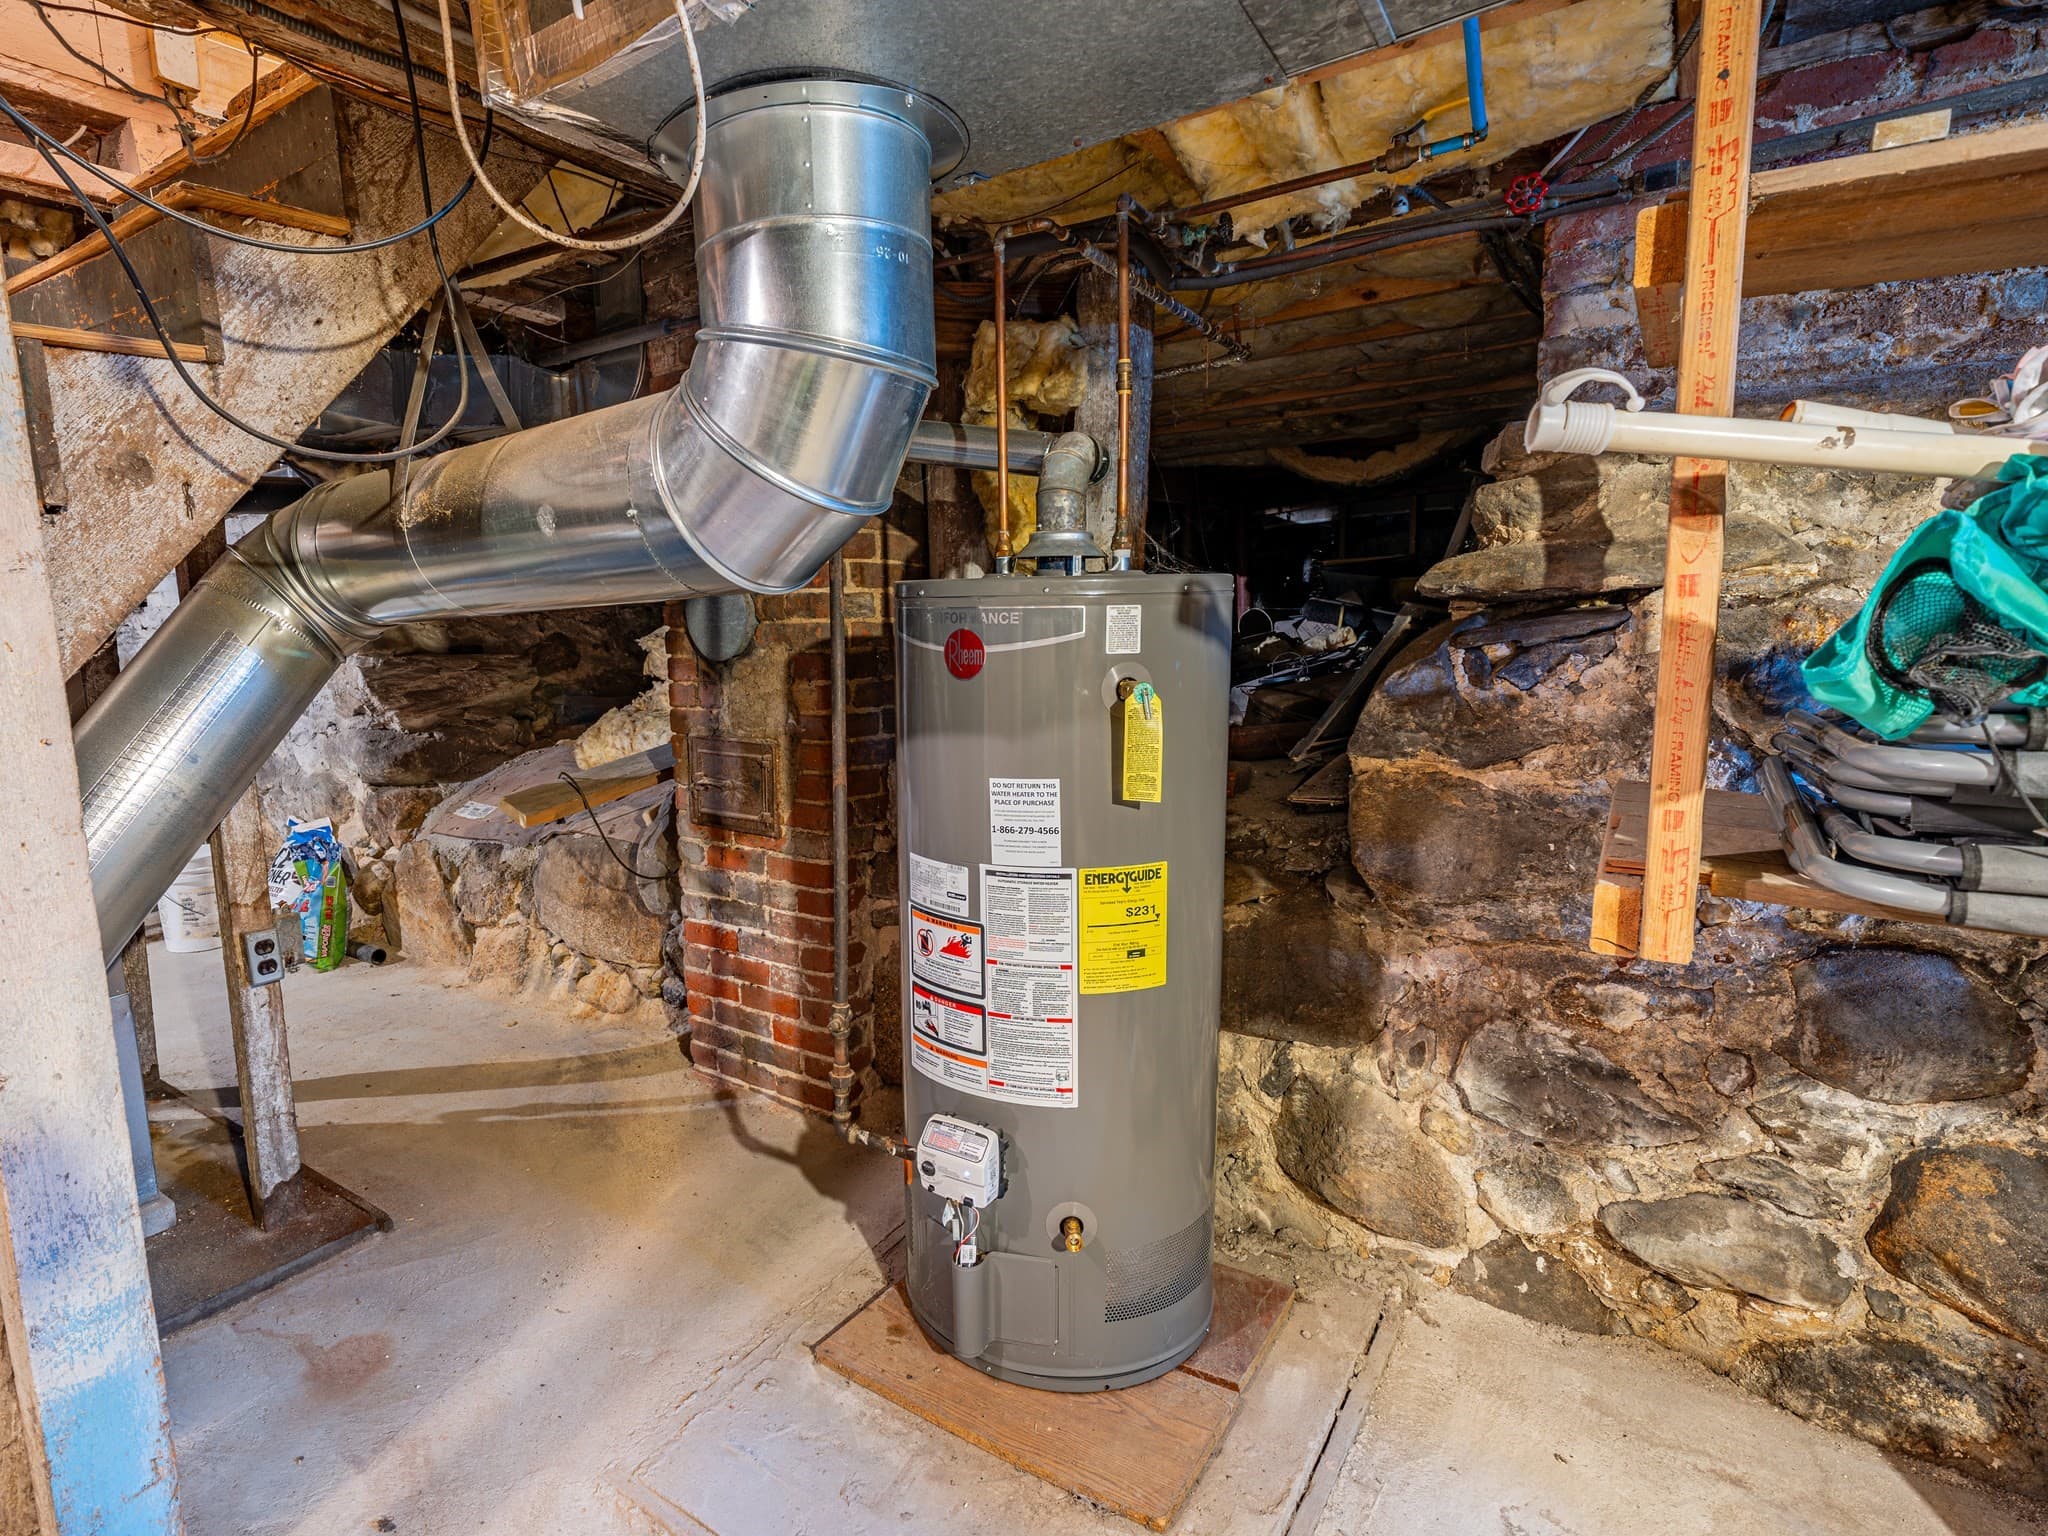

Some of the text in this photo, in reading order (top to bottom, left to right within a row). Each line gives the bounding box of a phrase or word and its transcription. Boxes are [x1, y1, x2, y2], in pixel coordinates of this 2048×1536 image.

[949, 631, 984, 672] Rheem
[1667, 731, 1684, 804] FRAMING
[991, 825, 1060, 835] 1-866-279-4566
[1125, 904, 1156, 918] $231
